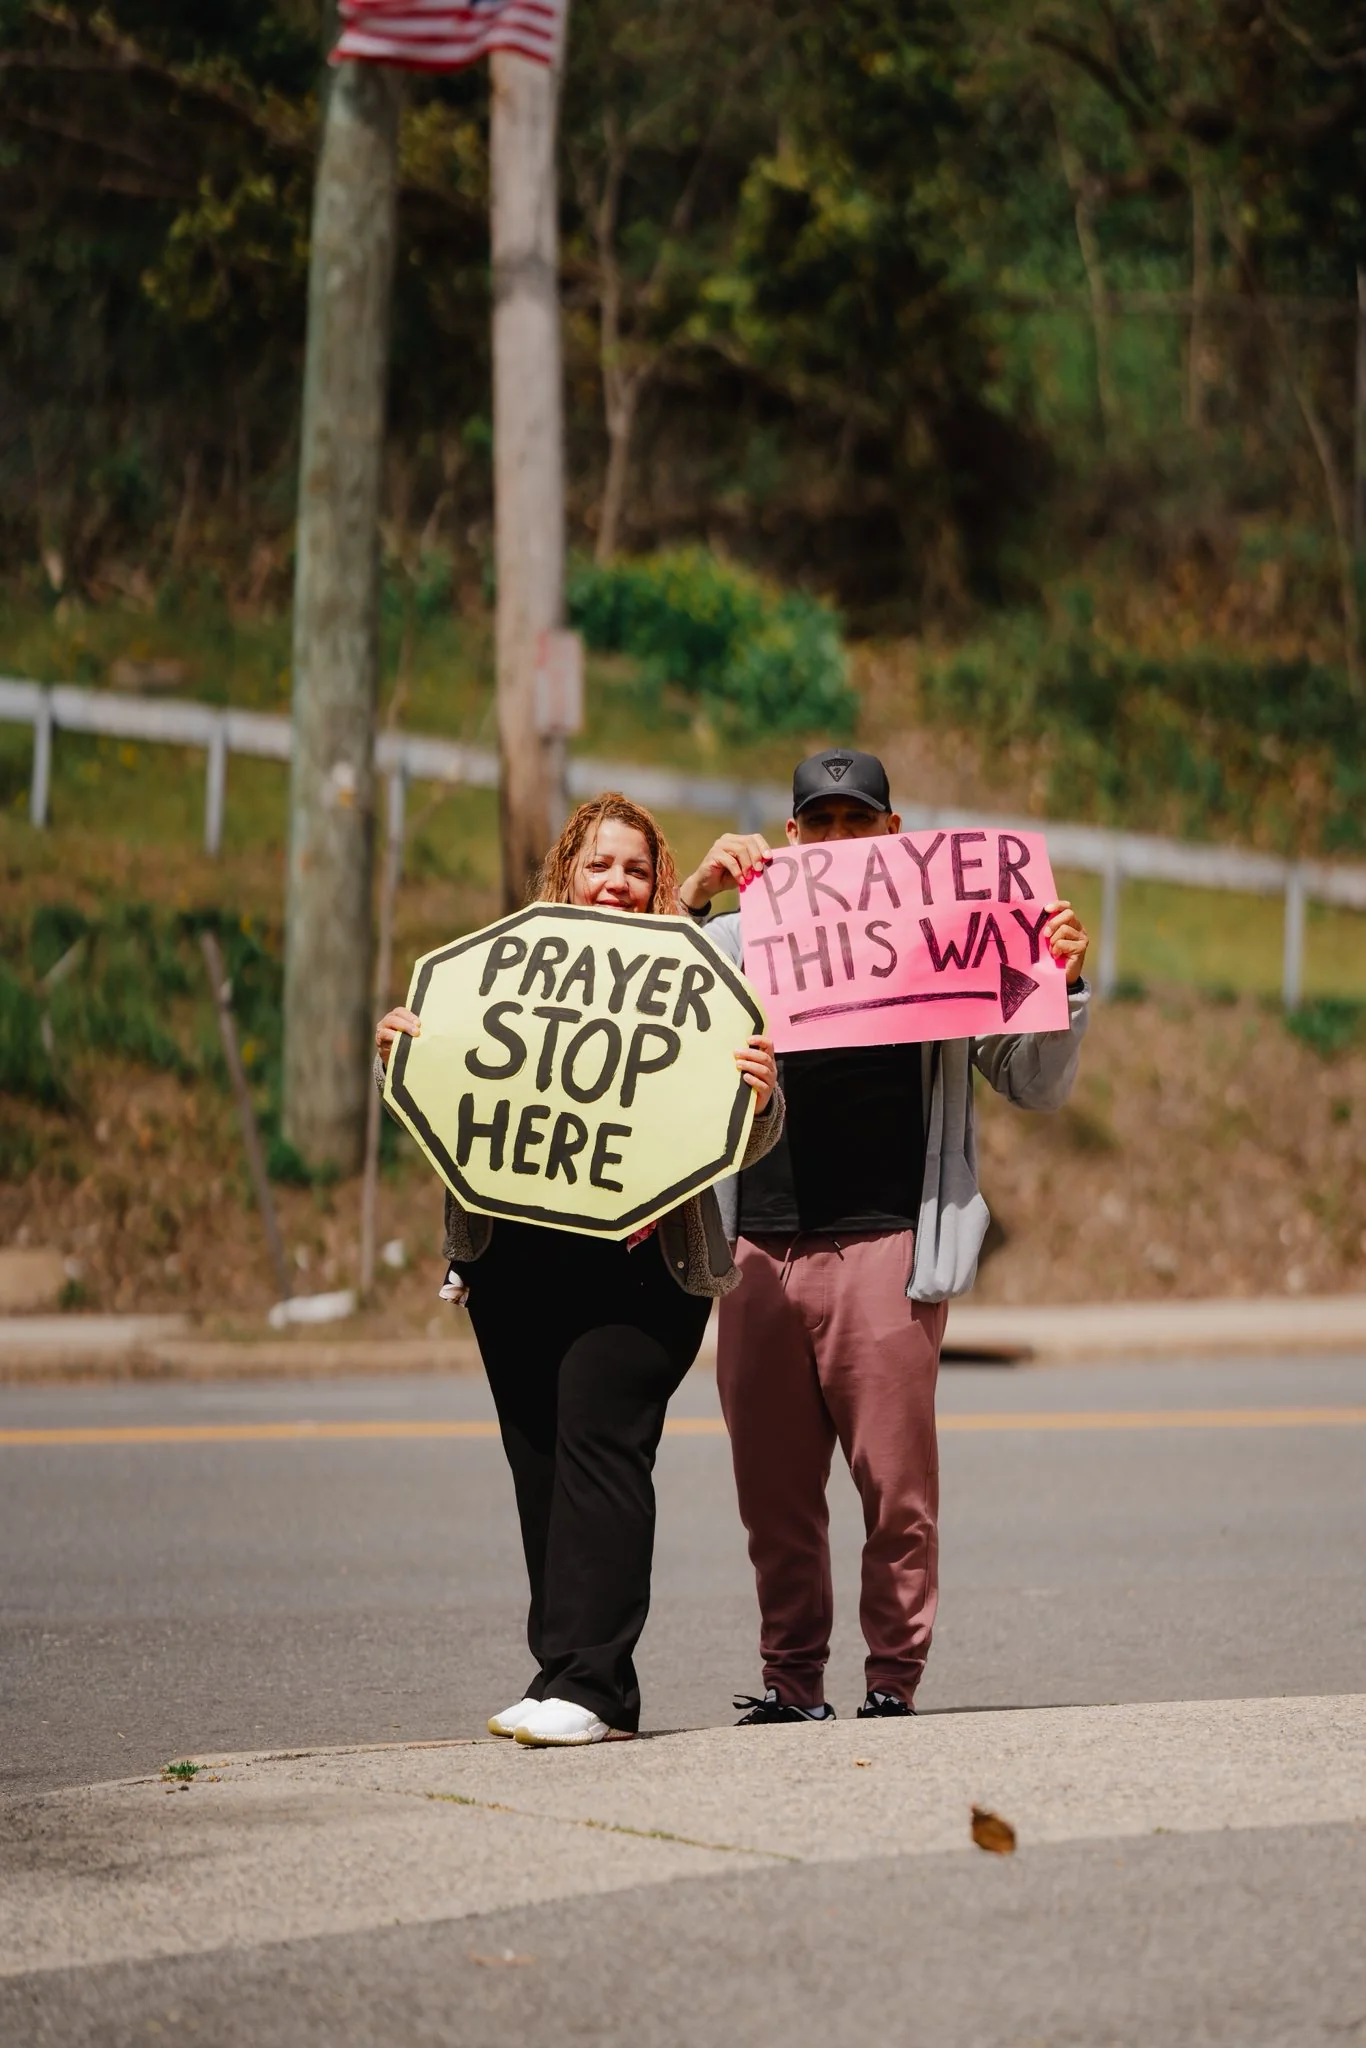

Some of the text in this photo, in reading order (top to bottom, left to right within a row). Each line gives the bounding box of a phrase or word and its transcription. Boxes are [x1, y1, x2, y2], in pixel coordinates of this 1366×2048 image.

[762, 832, 1034, 925] PRAYER
[478, 935, 715, 1032] PRAYER
[748, 907, 1050, 995] THIS WAY
[464, 1001, 681, 1108] STOP
[455, 1092, 632, 1192] HERE
